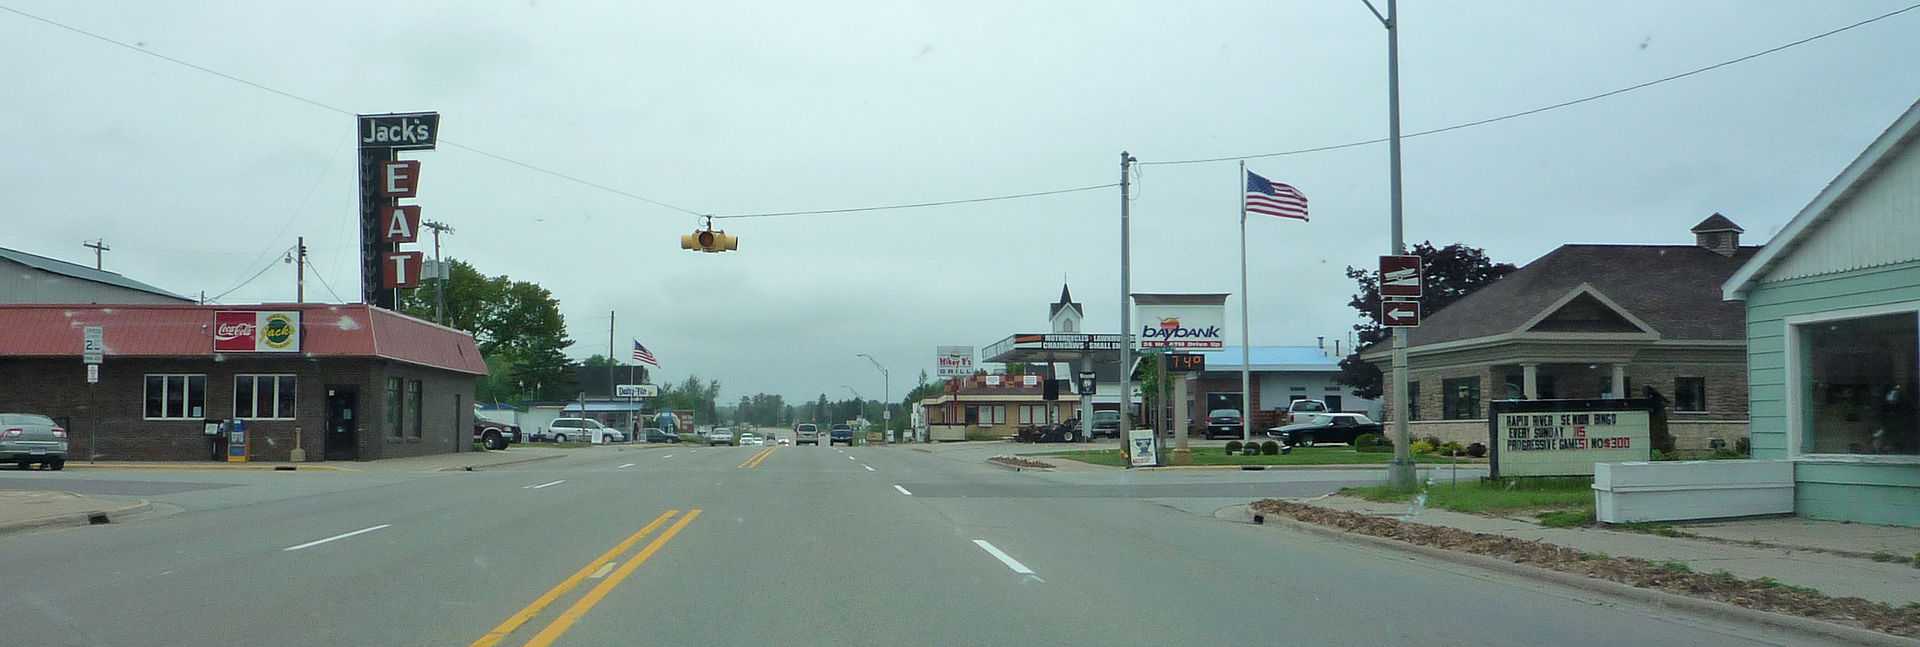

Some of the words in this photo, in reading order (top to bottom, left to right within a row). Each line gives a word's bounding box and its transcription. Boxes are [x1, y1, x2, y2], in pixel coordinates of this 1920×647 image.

[363, 118, 429, 144] Jack's
[1506, 415, 1529, 427] RAPID
[1532, 415, 1553, 427] RIVER
[1594, 413, 1617, 425] BINGO
[1509, 428, 1530, 439] EVERY
[1534, 427, 1564, 438] SUNDAY
[1507, 439, 1557, 451] PROGRESSIVE
